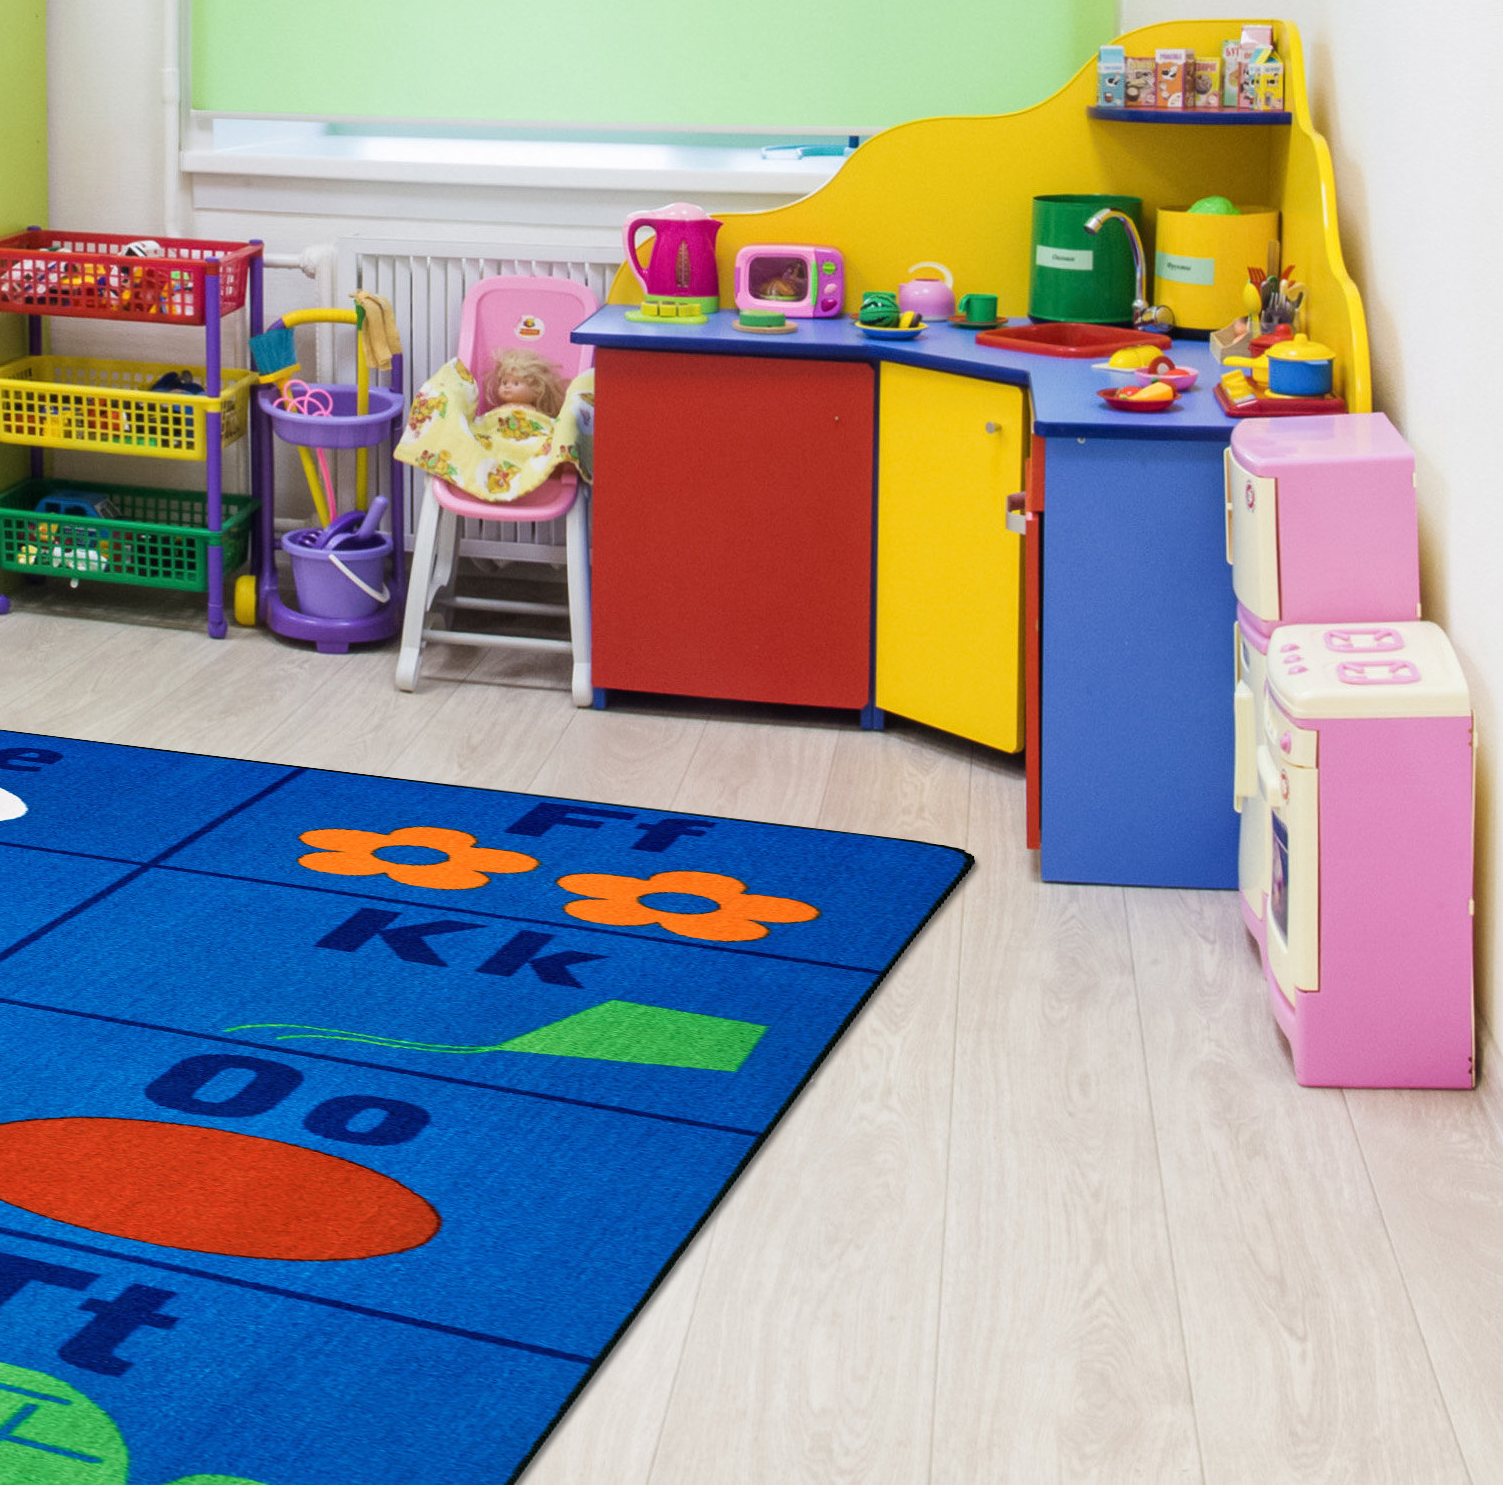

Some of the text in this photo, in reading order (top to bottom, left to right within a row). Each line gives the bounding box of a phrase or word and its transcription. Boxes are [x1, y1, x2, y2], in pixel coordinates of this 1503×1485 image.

[503, 801, 720, 854] Ff
[313, 907, 611, 990] Kk
[144, 1053, 431, 1147] Oo
